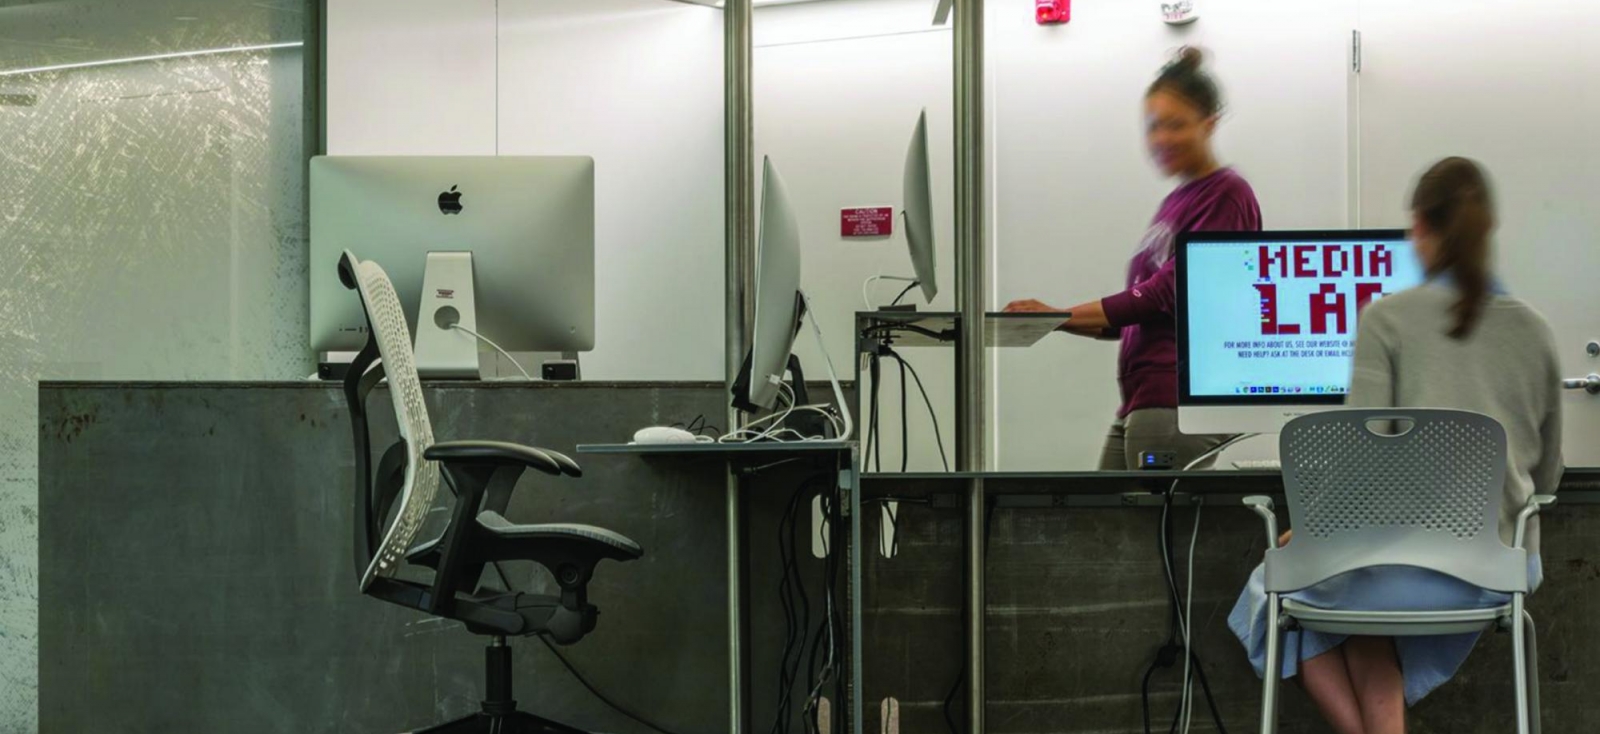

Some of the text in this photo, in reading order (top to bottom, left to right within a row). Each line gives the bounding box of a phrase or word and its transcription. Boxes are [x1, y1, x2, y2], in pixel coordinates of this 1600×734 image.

[1259, 245, 1392, 278] MEDIA
[1224, 341, 1235, 349] FOR
[1236, 341, 1251, 349] MORE
[1252, 341, 1266, 349] INFO
[1266, 340, 1284, 348] ABOUT
[1295, 340, 1305, 348] SEE
[1306, 340, 1318, 348] OUR
[1319, 340, 1340, 348] WEBSITE
[1238, 350, 1252, 358] NEED
[1253, 350, 1270, 358] HELP?
[1270, 350, 1281, 358] ASK
[1281, 350, 1289, 358] AT
[1300, 350, 1314, 358] DESK
